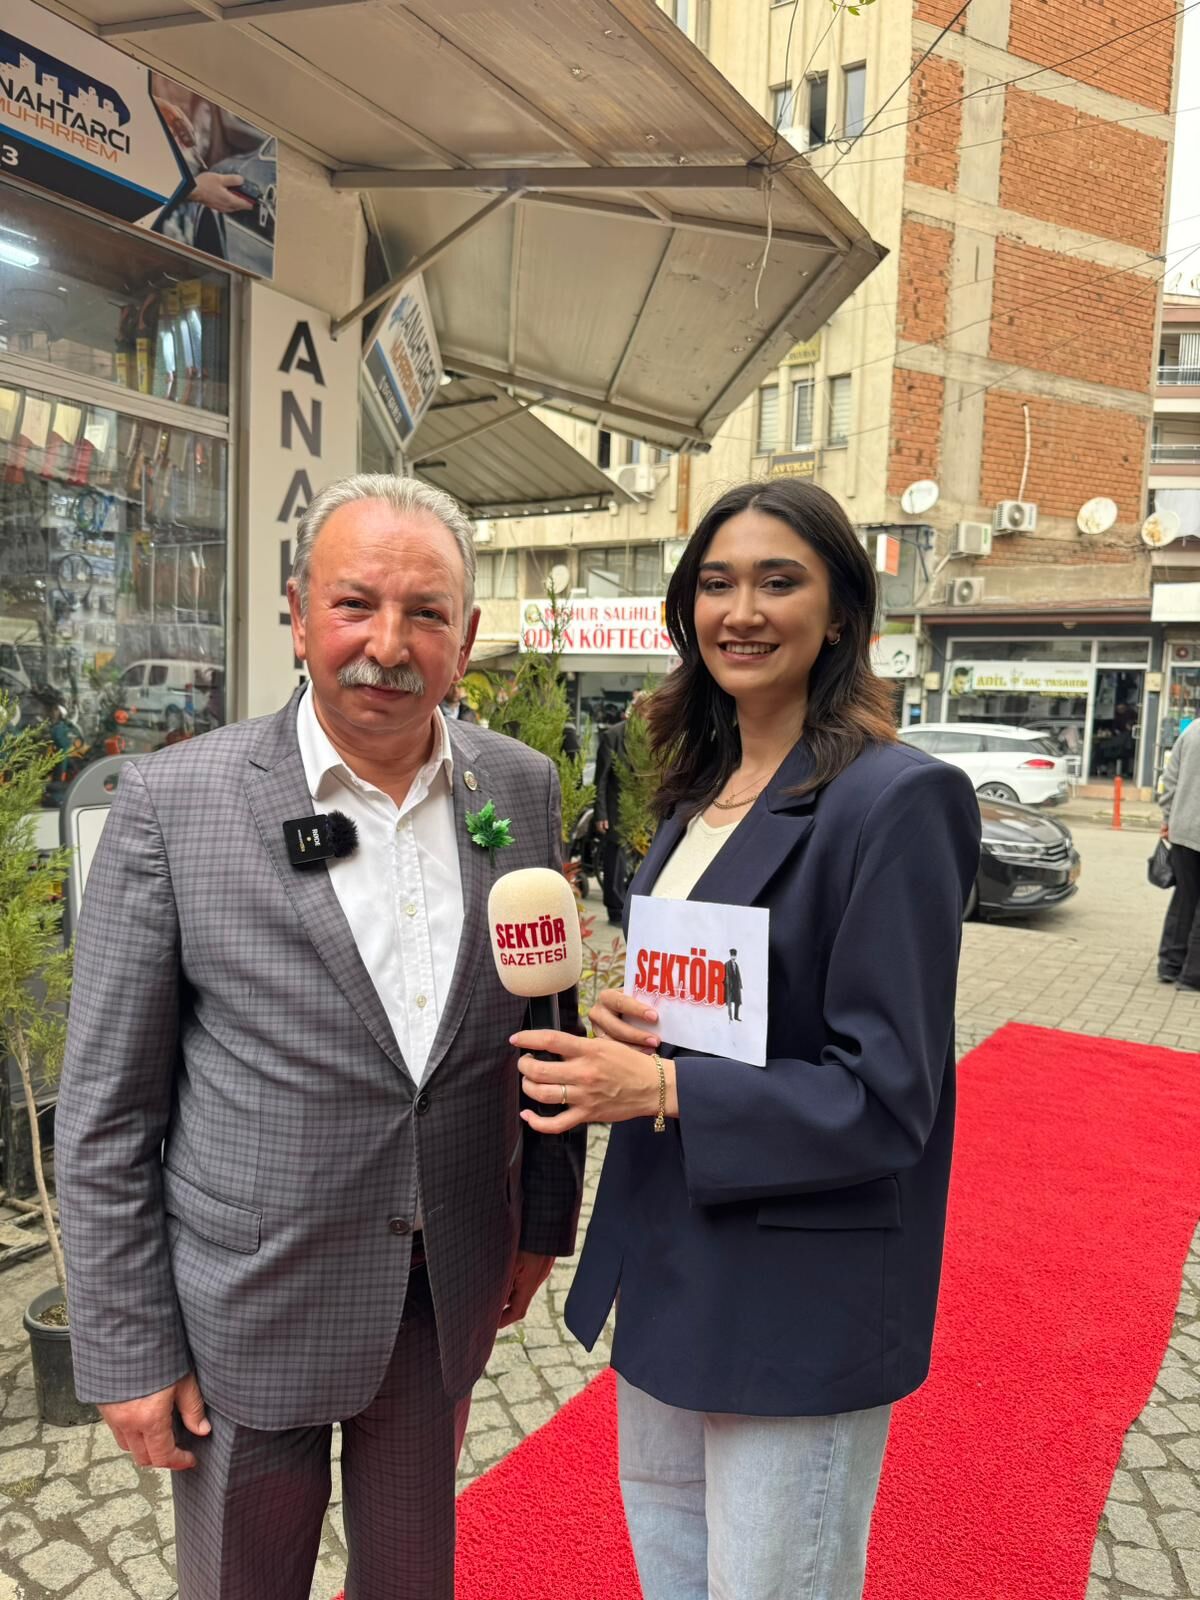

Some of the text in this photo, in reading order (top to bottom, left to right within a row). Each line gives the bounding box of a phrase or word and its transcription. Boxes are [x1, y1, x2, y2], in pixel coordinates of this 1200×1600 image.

[495, 914, 567, 949] SEKTÖR
[500, 945, 566, 966] GAZETESİ
[635, 947, 727, 1006] SEKTÖR
